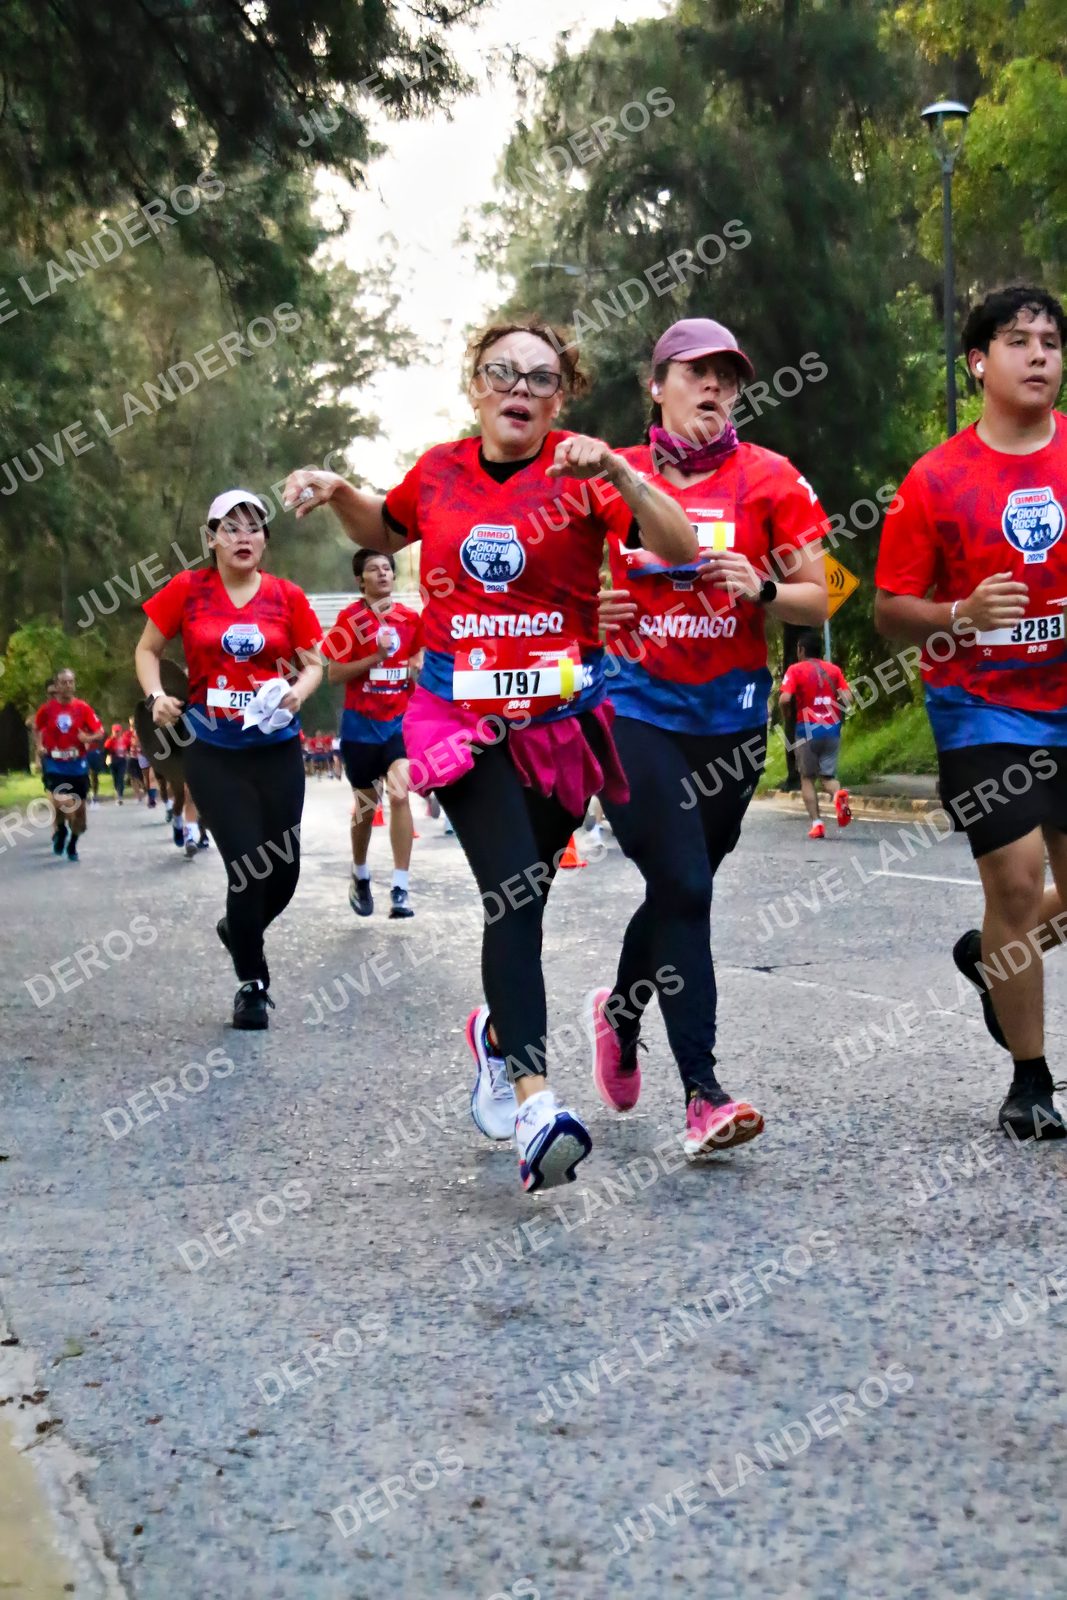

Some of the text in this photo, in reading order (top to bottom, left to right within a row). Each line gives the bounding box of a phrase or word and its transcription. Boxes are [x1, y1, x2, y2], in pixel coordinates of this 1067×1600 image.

[1014, 494, 1048, 505] BIMBO
[1017, 508, 1048, 519] Global
[1012, 518, 1038, 530] Race
[477, 530, 510, 540] BIMBO
[476, 543, 509, 554] Global
[470, 551, 497, 562] Race
[1026, 553, 1045, 562] 2026
[451, 611, 564, 639] SANTIAGO
[639, 614, 737, 639] SANTIAGO
[1011, 617, 1061, 643] 3283
[493, 671, 541, 696] 1797
[230, 692, 258, 708] 215
